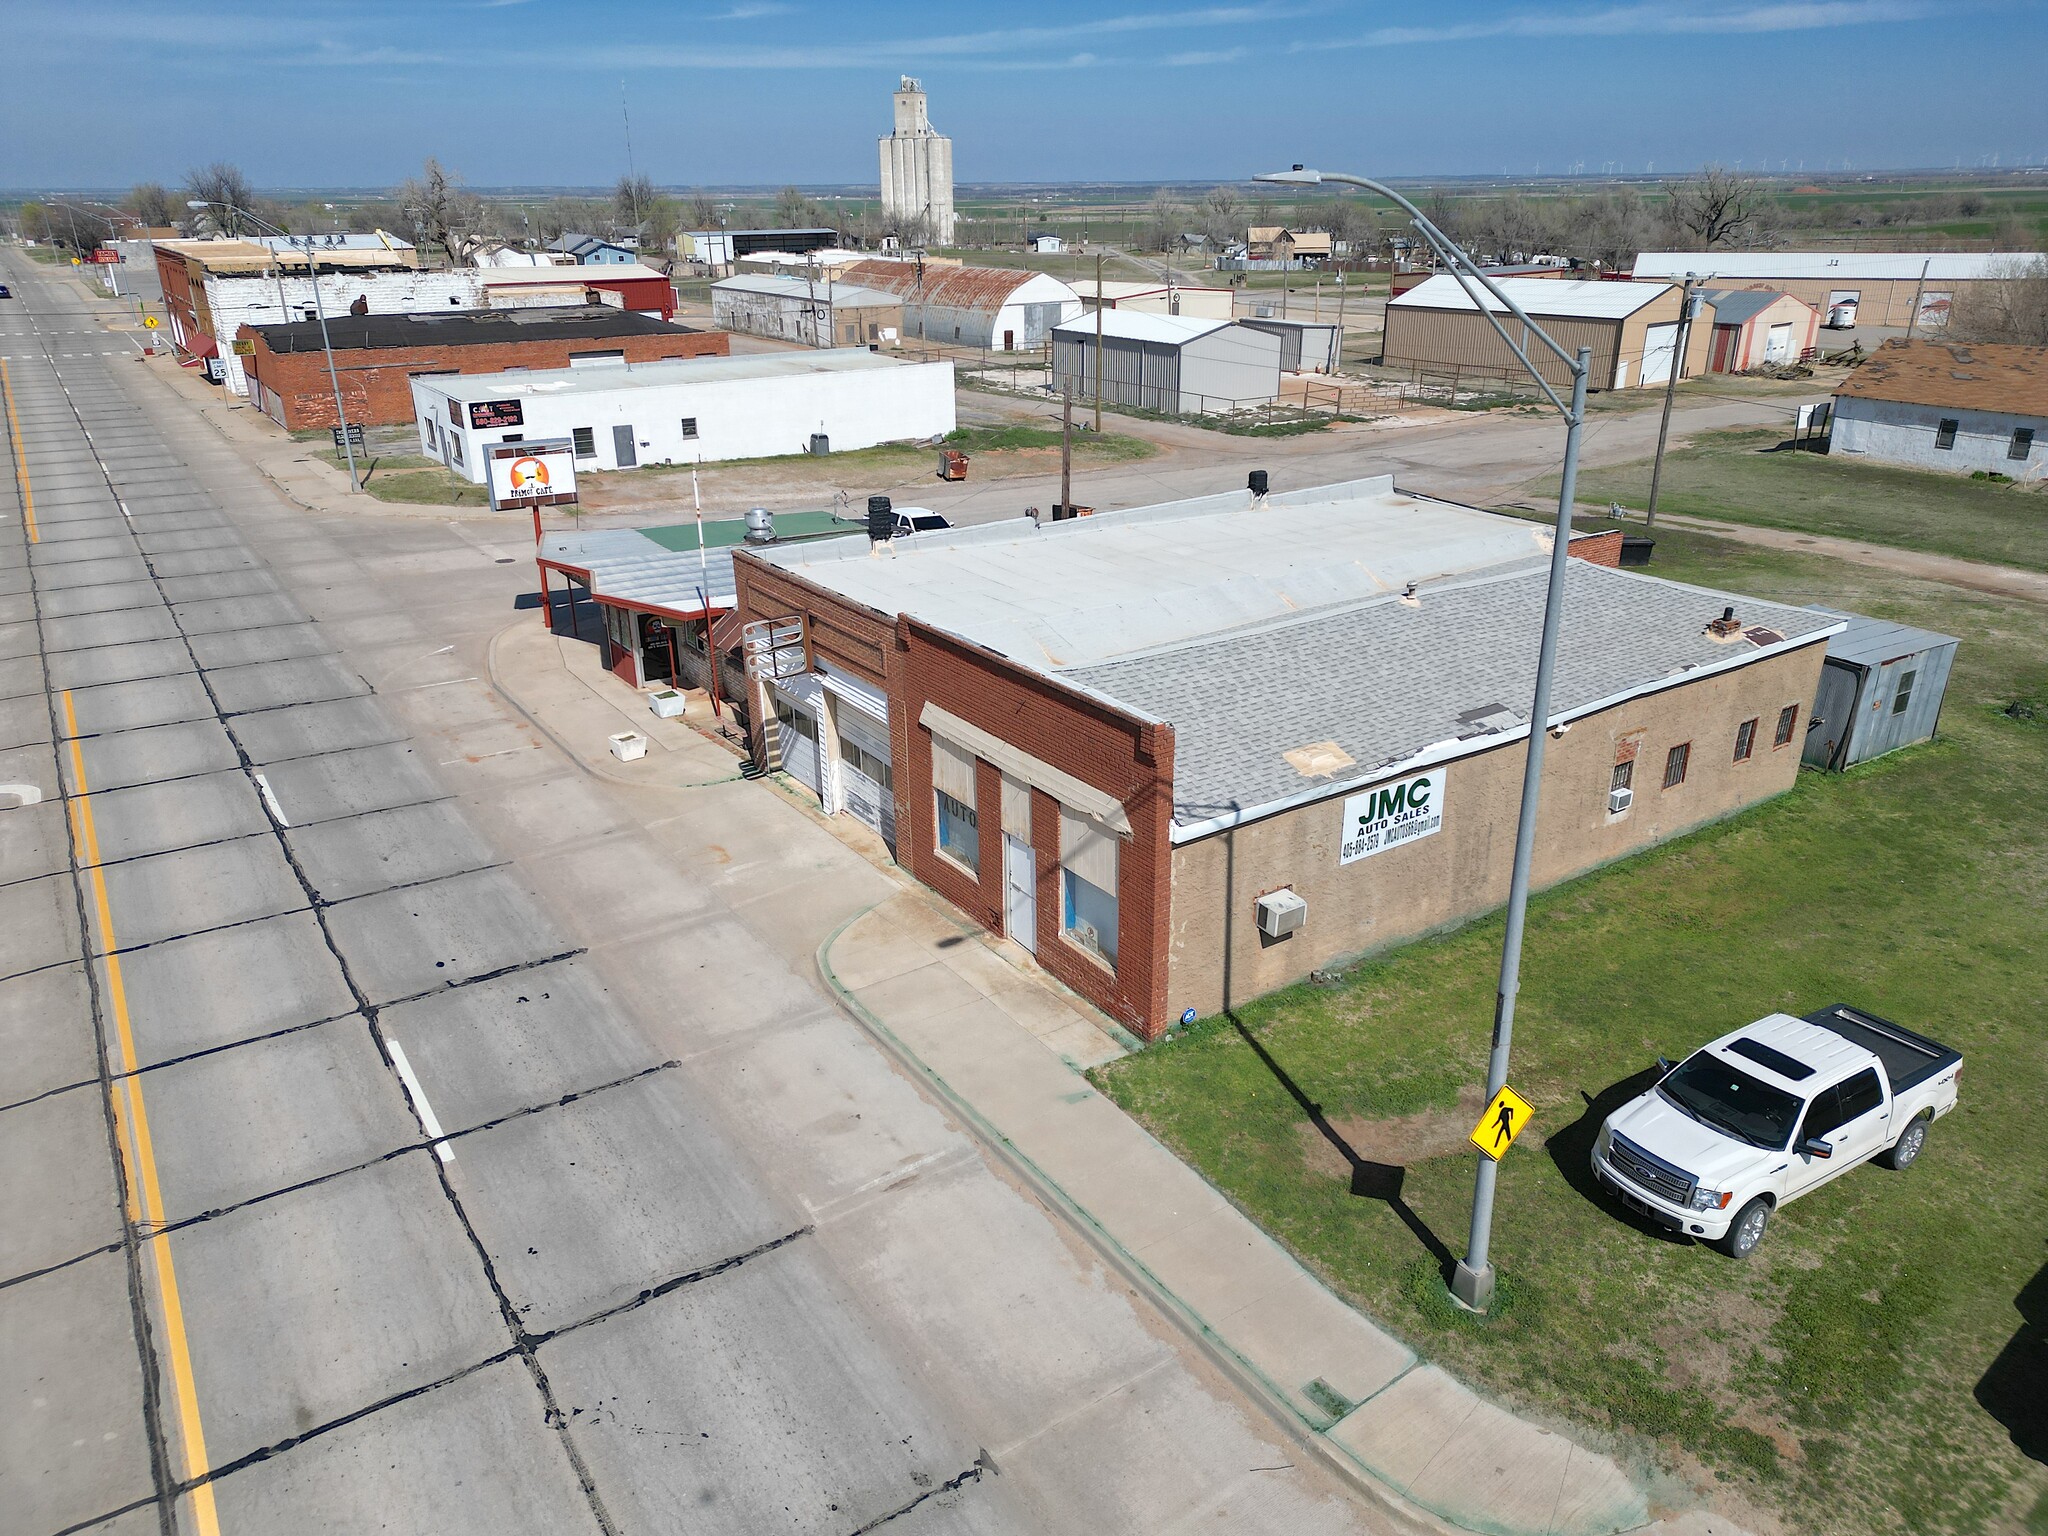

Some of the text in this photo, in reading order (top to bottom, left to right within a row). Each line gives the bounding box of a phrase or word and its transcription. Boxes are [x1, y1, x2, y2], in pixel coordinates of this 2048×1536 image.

[214, 369, 227, 377] 25
[943, 796, 976, 828] AUTO
[1358, 778, 1431, 825] JMC
[1357, 804, 1430, 837] AUTO SALES
